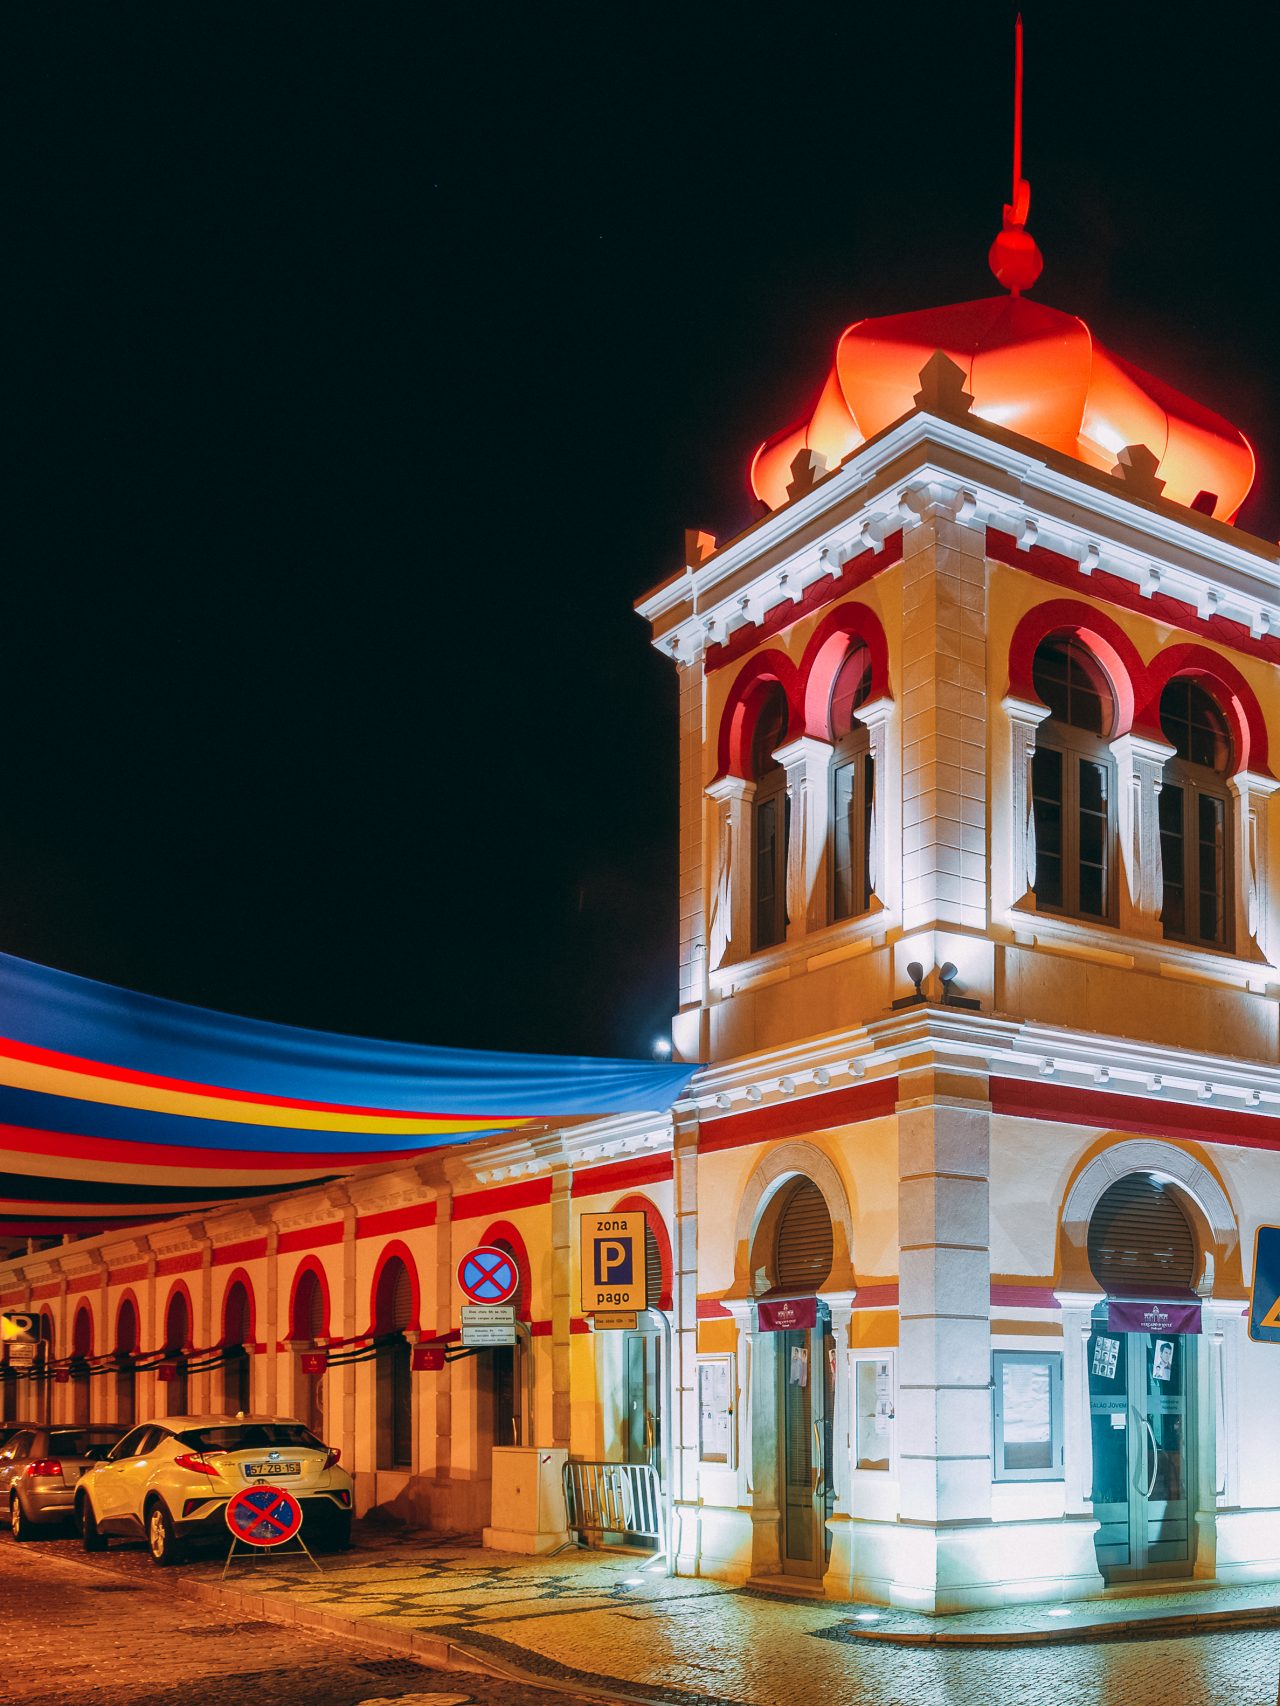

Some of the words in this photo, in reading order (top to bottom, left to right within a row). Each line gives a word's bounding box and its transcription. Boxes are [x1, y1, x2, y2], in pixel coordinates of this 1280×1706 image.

[597, 1221, 627, 1231] zona
[600, 1241, 626, 1282] P
[597, 1292, 630, 1305] pago
